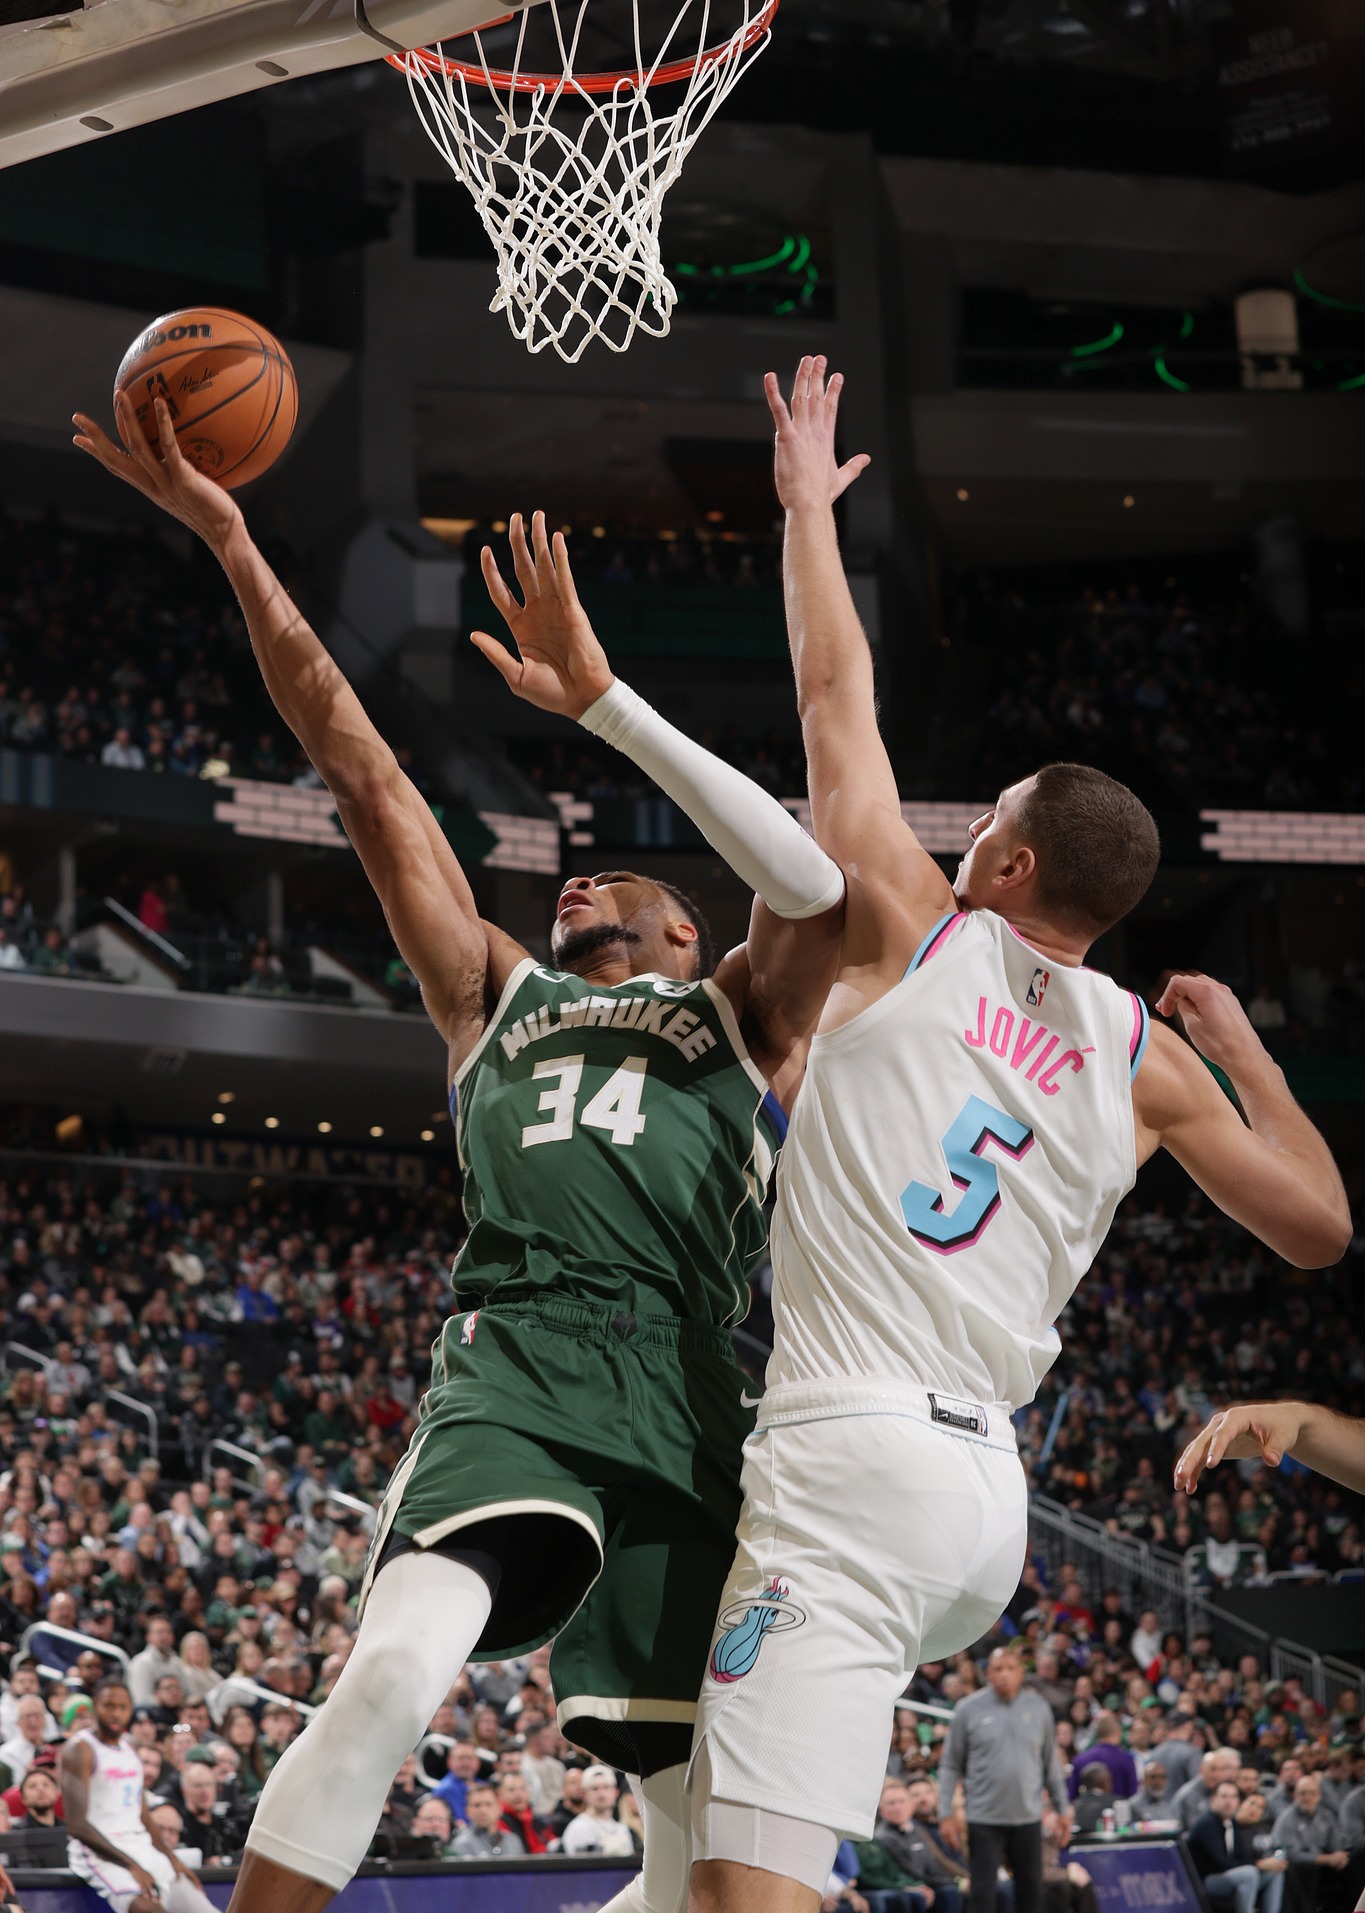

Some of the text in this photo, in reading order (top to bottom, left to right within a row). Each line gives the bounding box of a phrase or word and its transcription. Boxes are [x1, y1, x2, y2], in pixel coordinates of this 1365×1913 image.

[499, 995, 718, 1064] MILWAUKEE
[964, 996, 1097, 1096] JOVIĆ
[521, 1053, 649, 1149] 34
[900, 1094, 1035, 1257] 5
